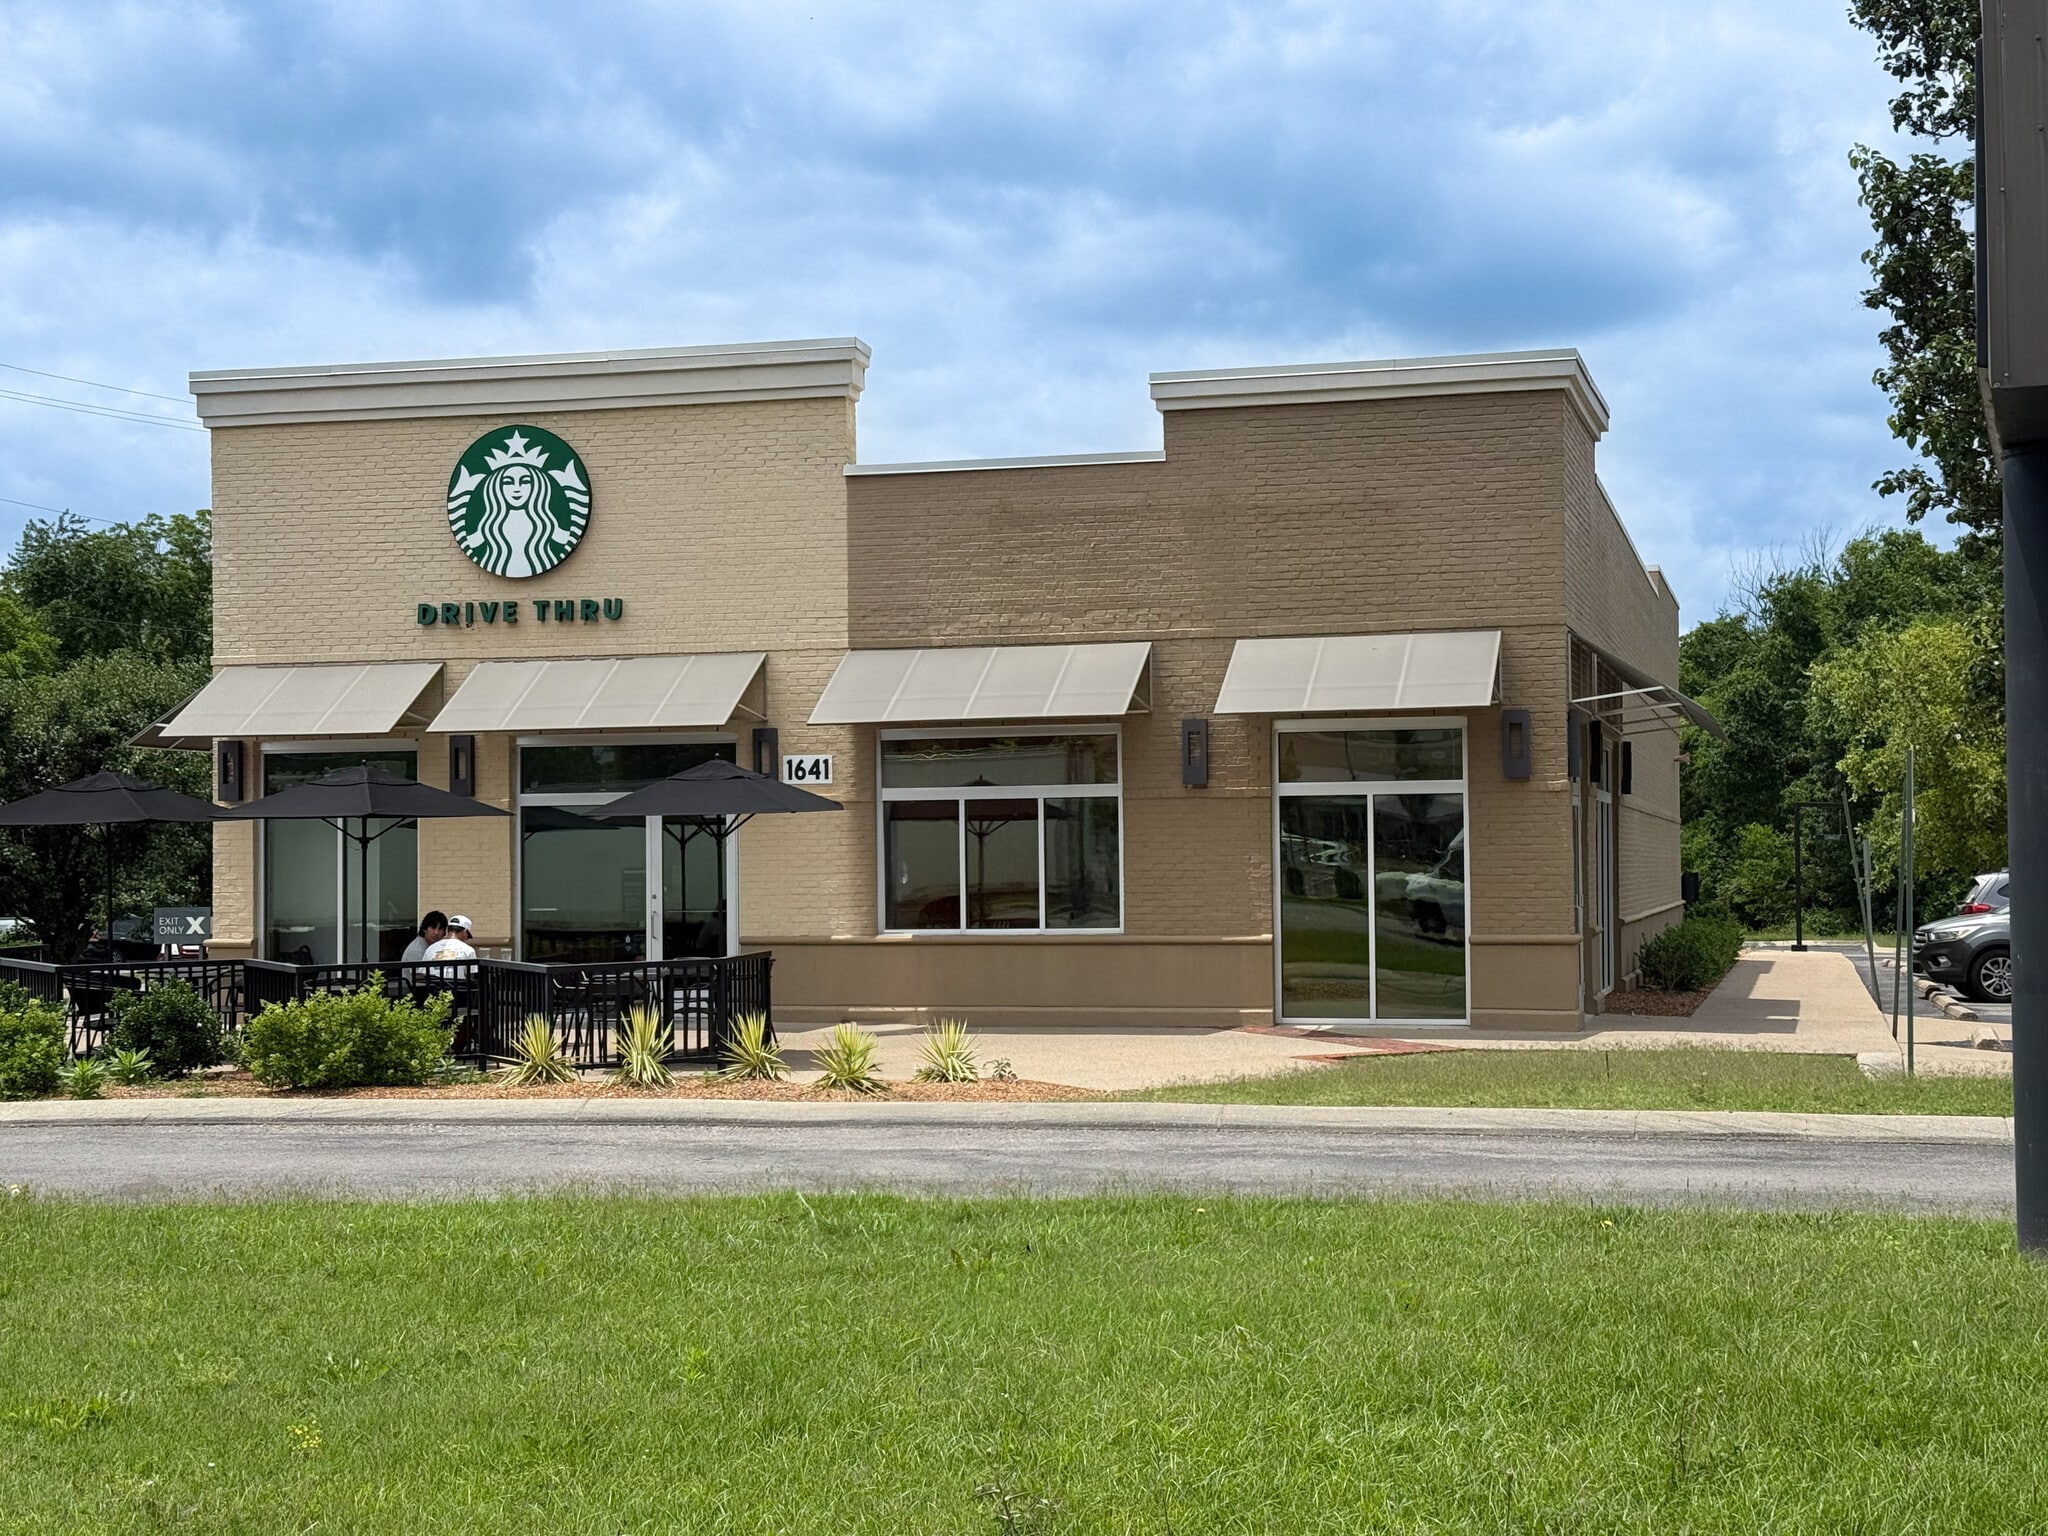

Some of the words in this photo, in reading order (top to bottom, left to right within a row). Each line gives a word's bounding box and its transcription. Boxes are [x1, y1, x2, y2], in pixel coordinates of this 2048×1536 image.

[417, 601, 519, 625] DRIVE
[533, 598, 623, 622] THRU
[786, 758, 829, 780] 1641
[159, 916, 179, 925] EXIT
[159, 926, 184, 935] ONLY
